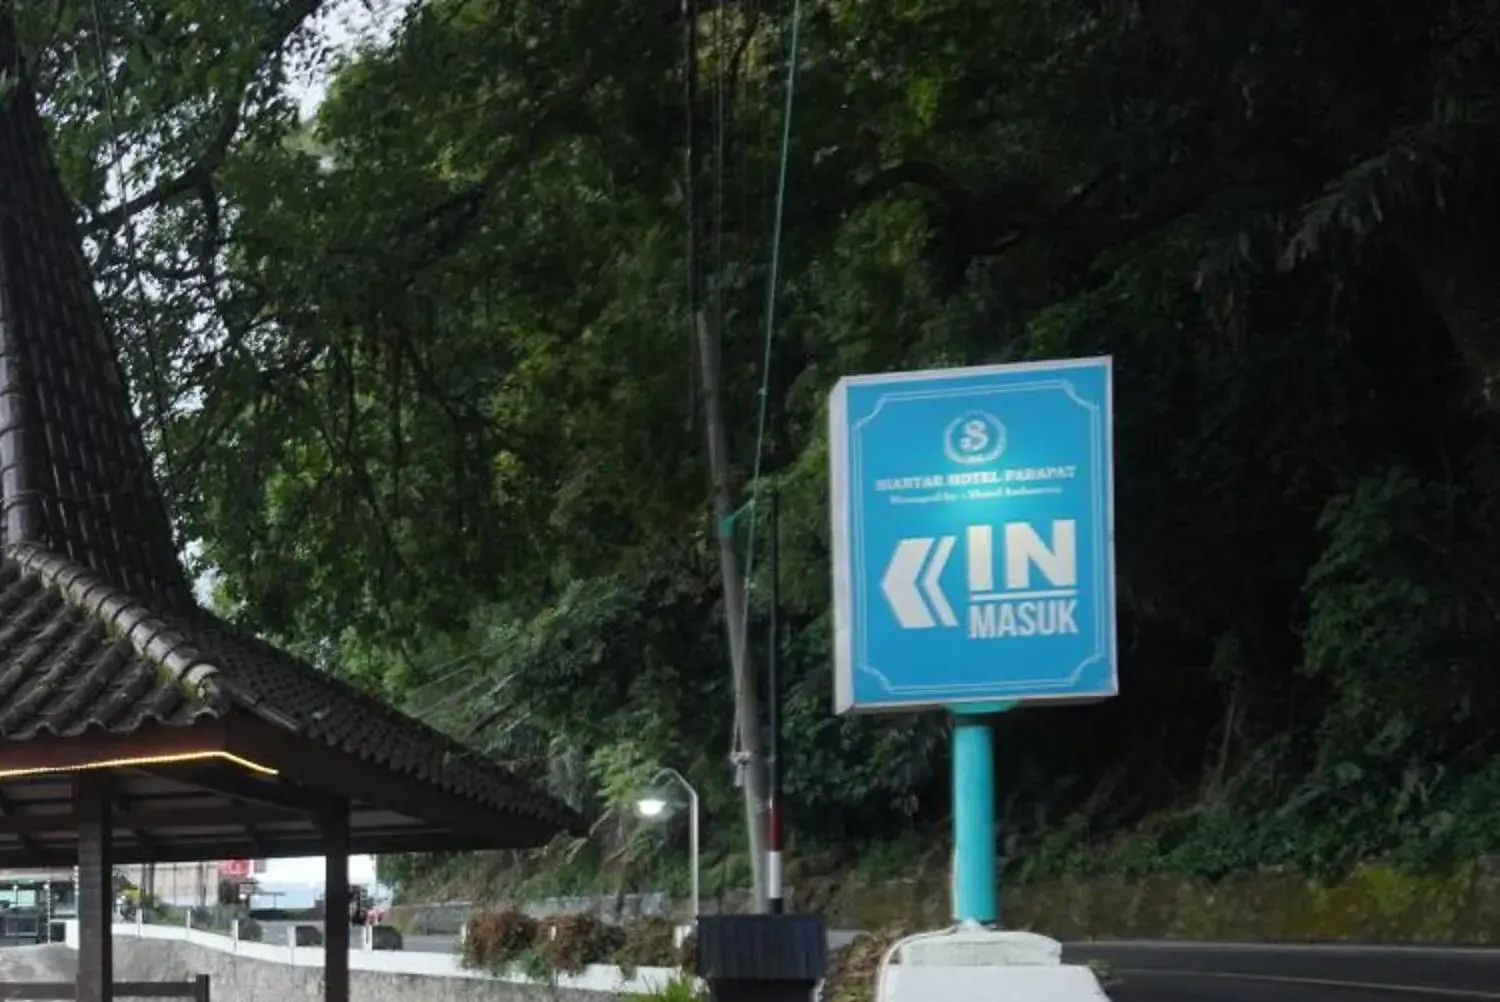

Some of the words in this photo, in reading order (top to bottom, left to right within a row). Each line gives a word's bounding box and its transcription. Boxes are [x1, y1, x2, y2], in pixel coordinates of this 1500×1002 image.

[947, 470, 998, 487] HOTEL
[966, 519, 1077, 593] IN
[968, 600, 1080, 640] MASUK
